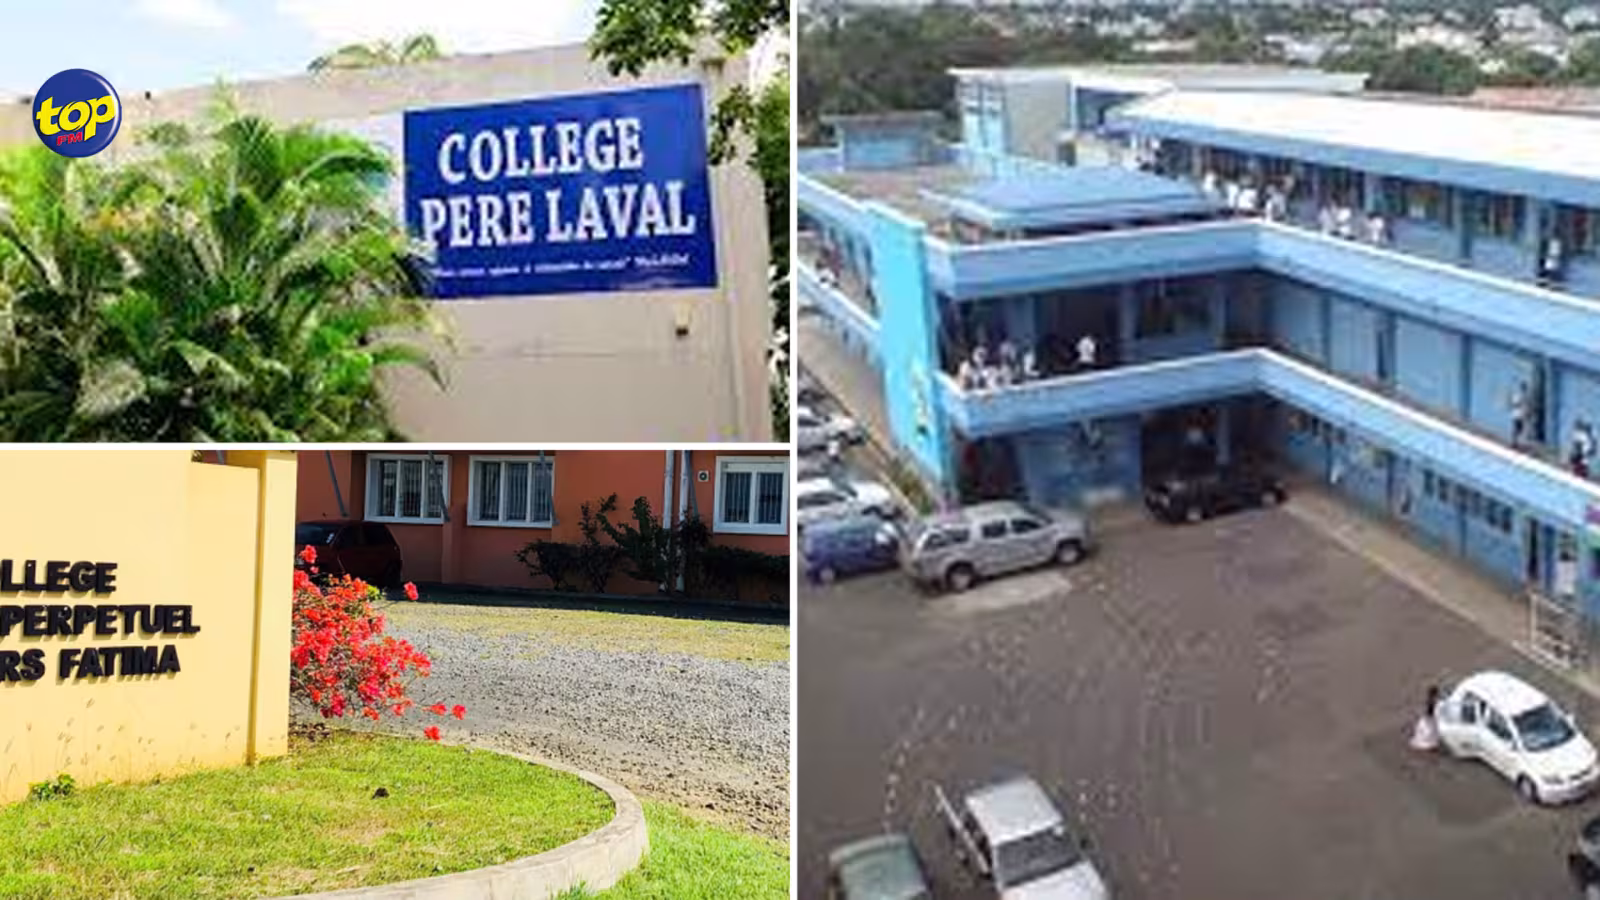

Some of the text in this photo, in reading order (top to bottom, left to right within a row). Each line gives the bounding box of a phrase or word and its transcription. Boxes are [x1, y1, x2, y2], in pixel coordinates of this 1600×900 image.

[438, 117, 644, 184] COLLEGE
[420, 180, 696, 250] PERE LAVAL
[0, 559, 118, 593] LLEGE
[0, 604, 201, 636] PERPETUEL
[0, 644, 181, 682] RS FATIMA
